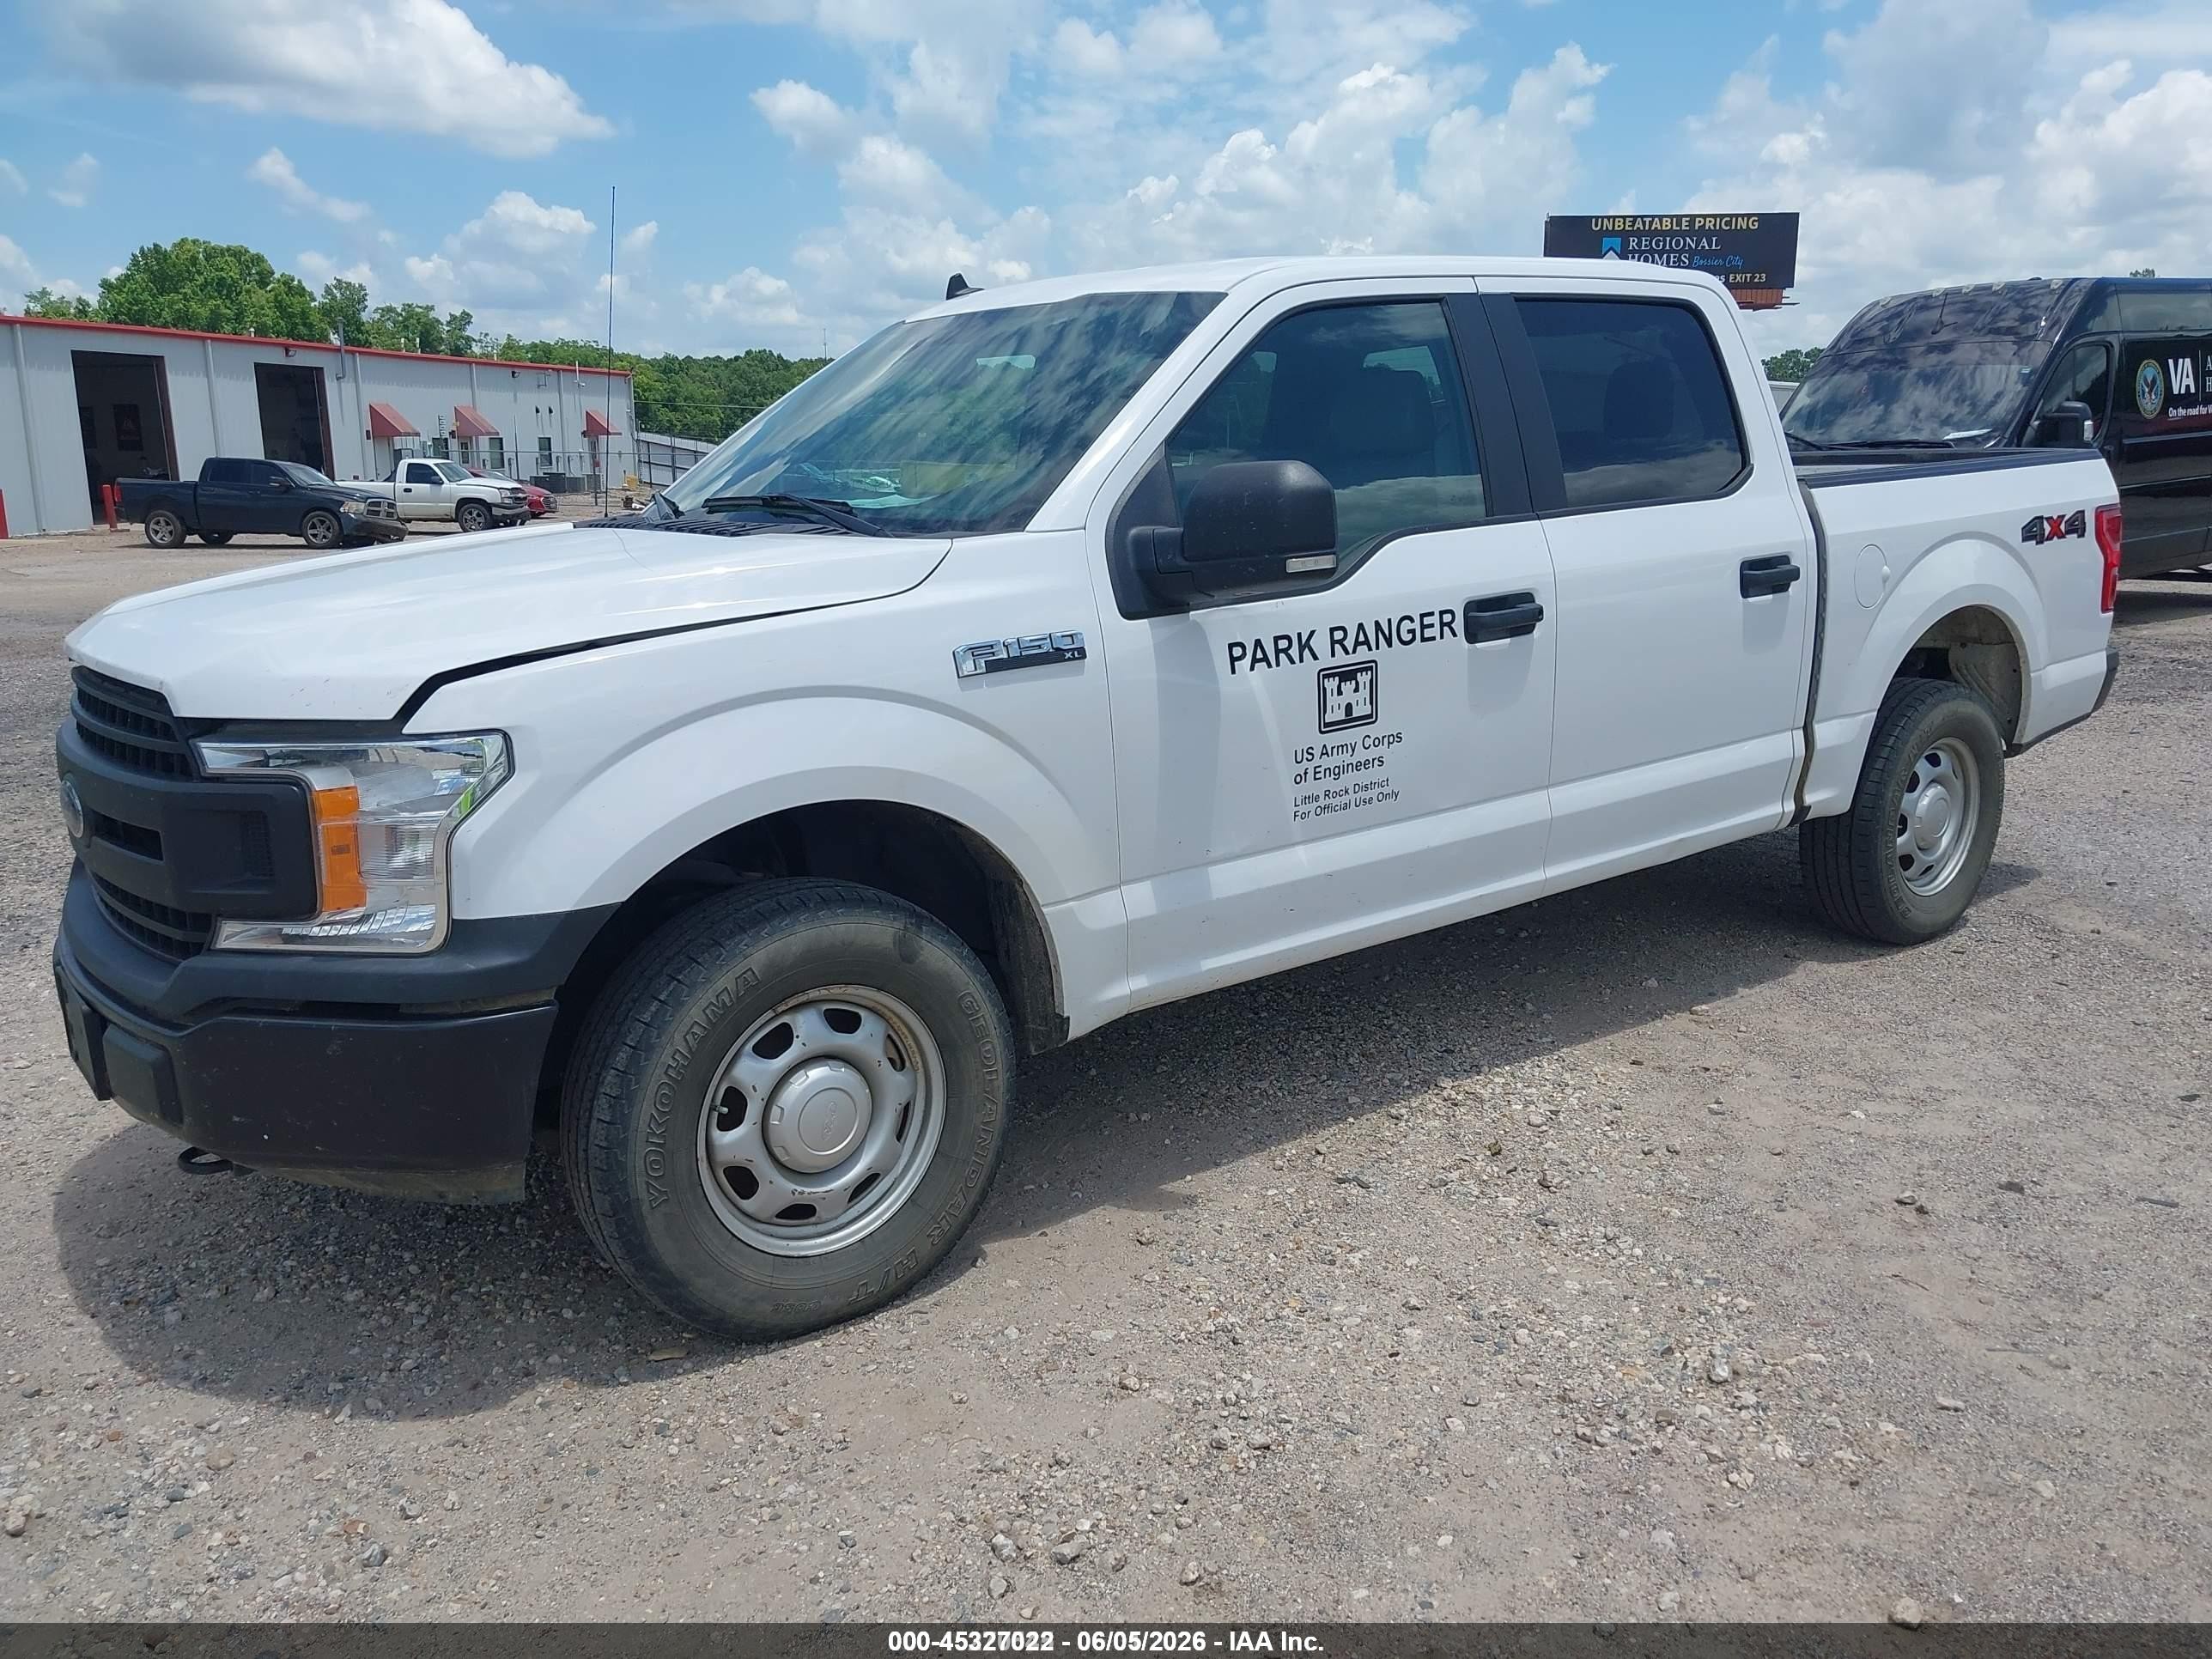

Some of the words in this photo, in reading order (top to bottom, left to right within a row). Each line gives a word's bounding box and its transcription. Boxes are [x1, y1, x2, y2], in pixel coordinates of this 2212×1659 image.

[1591, 217, 1691, 231] UNBEATABLE
[1694, 216, 1759, 230] PRICING
[1627, 236, 1721, 250] REGIONAL
[1627, 253, 1689, 266] HOMES
[1692, 256, 1724, 267] Bossier
[1725, 255, 1743, 269] City
[1729, 273, 1753, 283] EXIT
[1753, 273, 1766, 283] 23
[2167, 358, 2196, 395] VA
[2168, 407, 2177, 417] On
[2178, 405, 2187, 416] the
[2187, 404, 2199, 416] road
[2199, 404, 2208, 415] for
[1063, 651, 1083, 660] XL
[1227, 629, 1320, 675] PARK
[1329, 609, 1458, 658] RANGER
[1294, 746, 1315, 764] US
[1319, 741, 1357, 759] Army
[1362, 732, 1402, 750] Corps
[1294, 767, 1309, 785] of
[1313, 756, 1384, 781] Engineers
[1293, 809, 1312, 822] For
[1315, 799, 1351, 817] Official
[1354, 796, 1374, 808] Use
[1376, 789, 1400, 803] Only
[1294, 793, 1320, 807] Little
[1324, 786, 1350, 801] Rock
[1353, 776, 1389, 794] District
[645, 966, 761, 1209] YOKOHAMA
[927, 989, 999, 1244] GEOLANDAR
[848, 1248, 918, 1305] H/T
